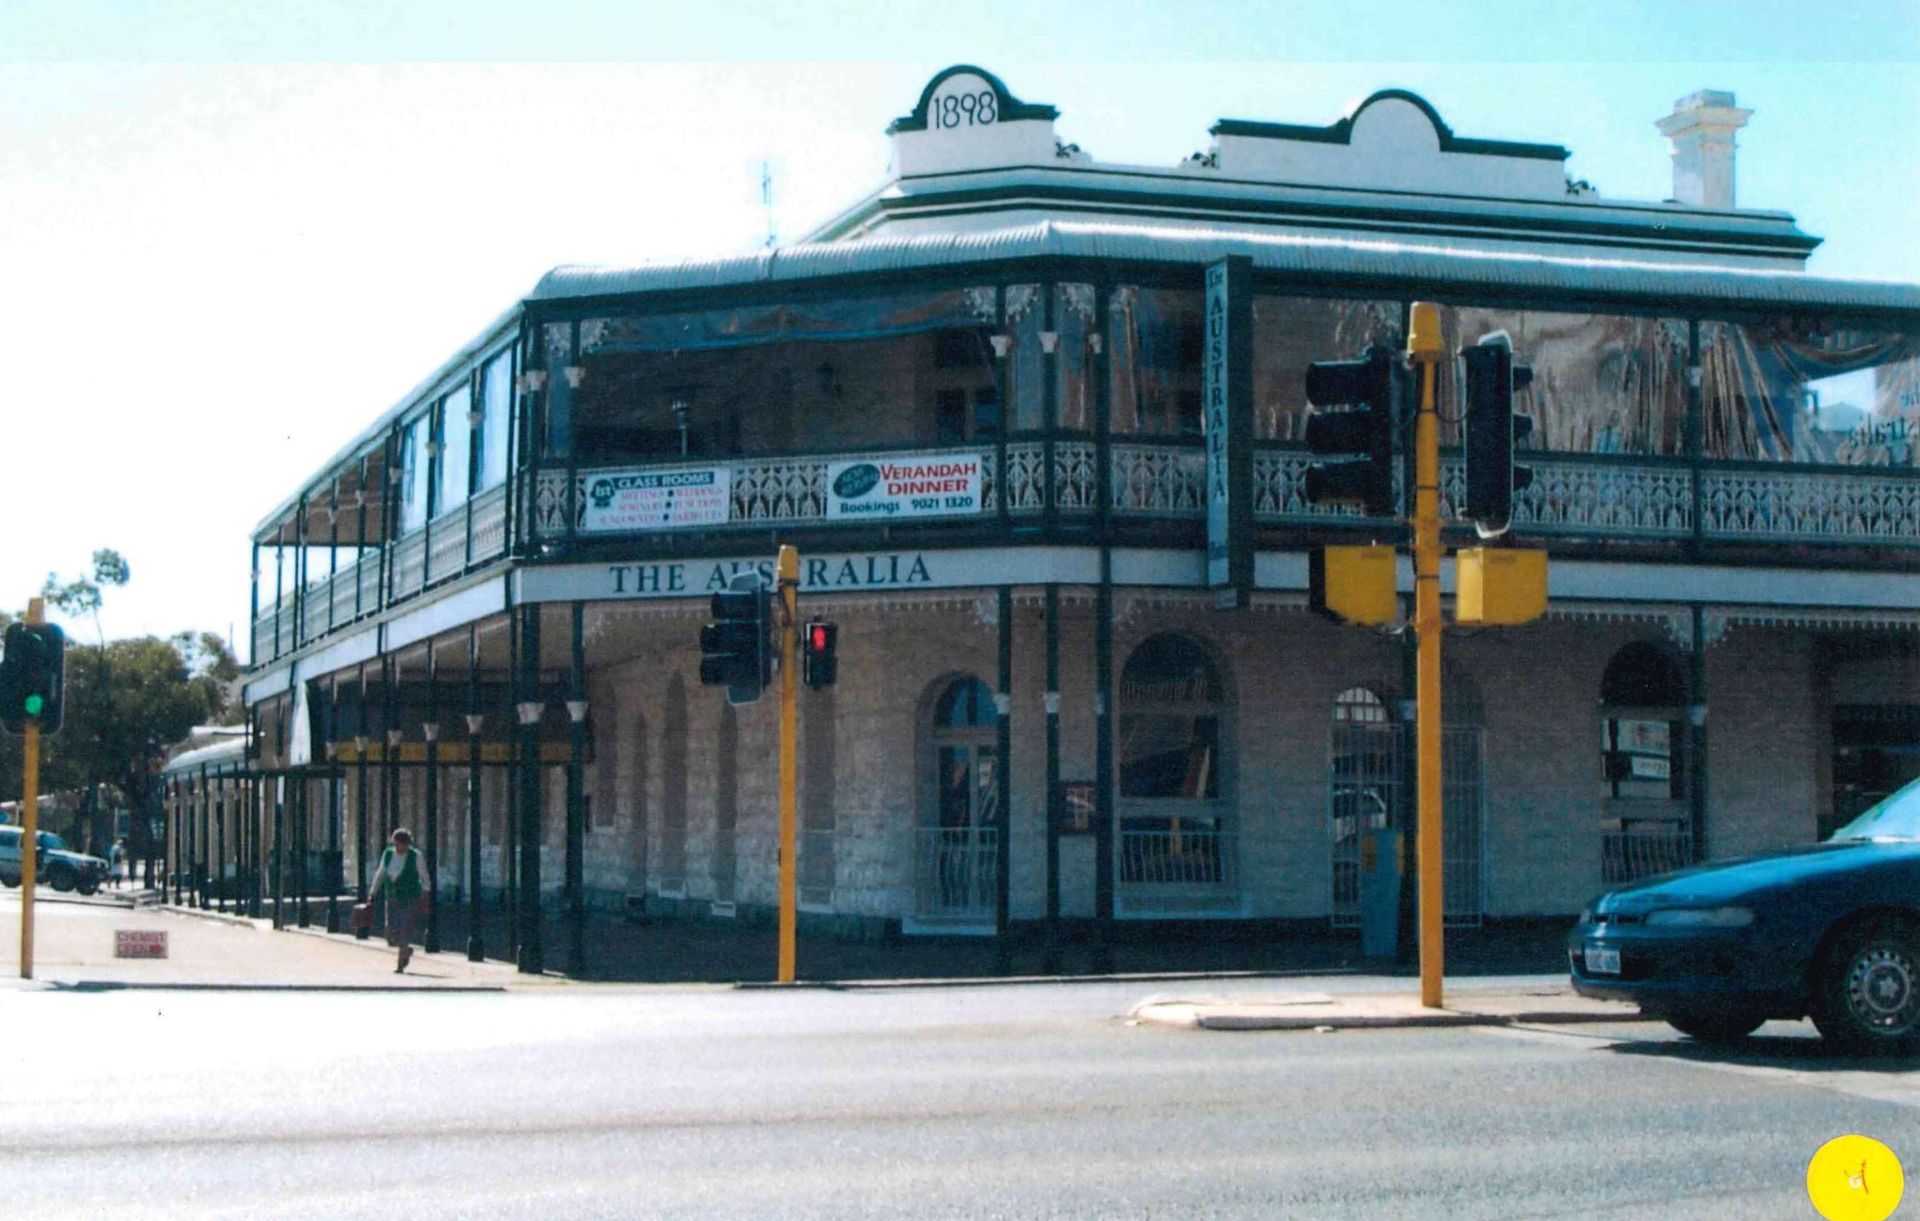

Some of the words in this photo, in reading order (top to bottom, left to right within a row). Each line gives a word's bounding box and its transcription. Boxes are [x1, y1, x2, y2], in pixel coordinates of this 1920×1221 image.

[935, 91, 996, 129] 1898
[1210, 295, 1225, 498] AUSTRALIA
[618, 476, 657, 489] CLASS
[662, 473, 711, 486] ROOMS
[880, 463, 977, 481] VERANDAH
[888, 479, 968, 496] DINNER
[840, 500, 900, 515] Bookings
[911, 497, 940, 510] 9021
[944, 496, 973, 508] 1320
[609, 564, 686, 593] THE
[706, 553, 932, 591] ASRALIA
